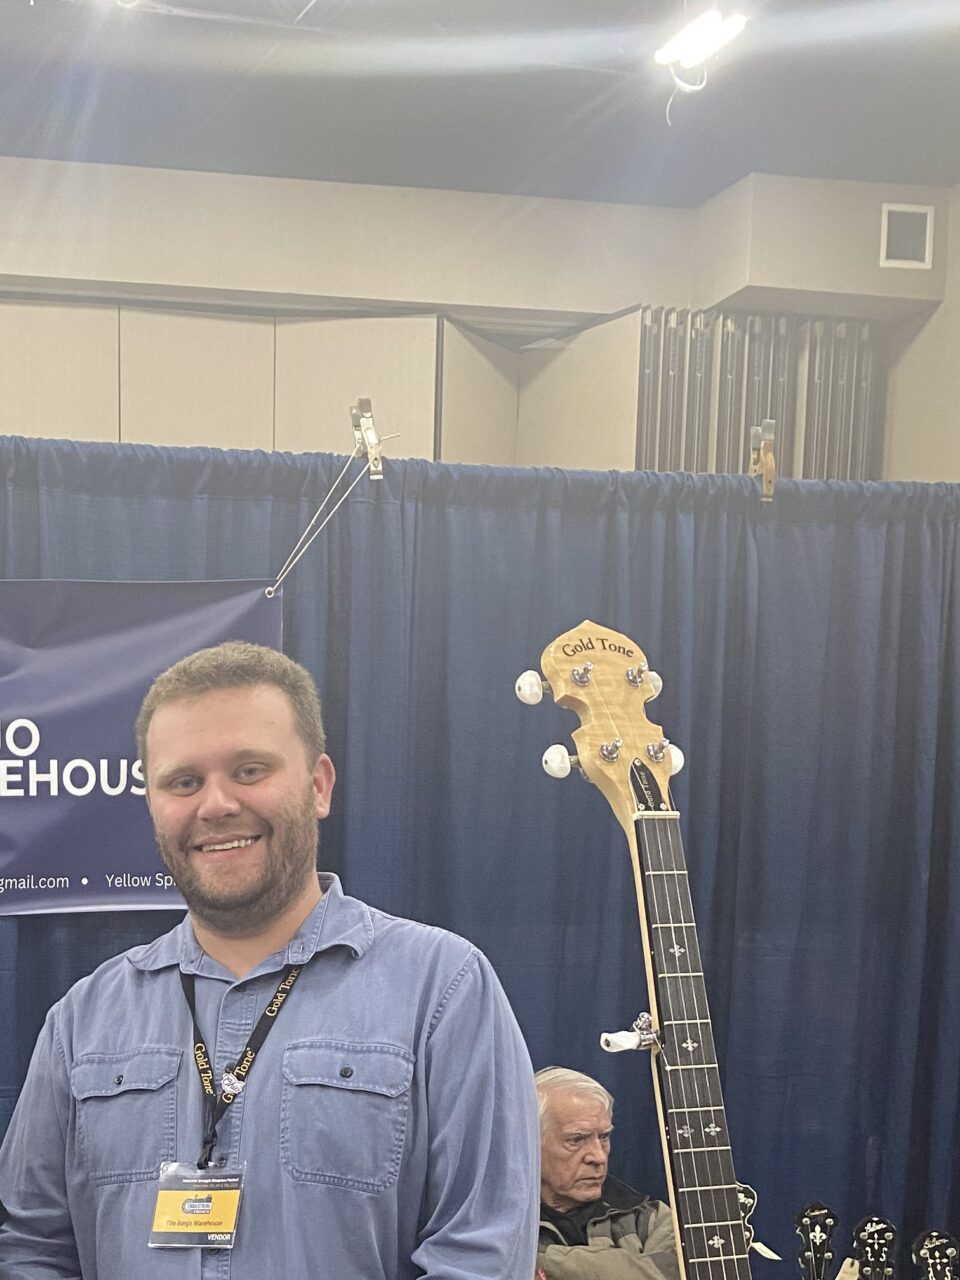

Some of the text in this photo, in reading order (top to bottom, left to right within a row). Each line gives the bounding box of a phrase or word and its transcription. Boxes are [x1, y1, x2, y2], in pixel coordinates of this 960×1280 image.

[562, 637, 634, 658] Gold Tone
[106, 873, 152, 887] Yellow
[155, 873, 177, 889] Sp
[265, 994, 287, 1017] Gold
[194, 1043, 207, 1070] Gold
